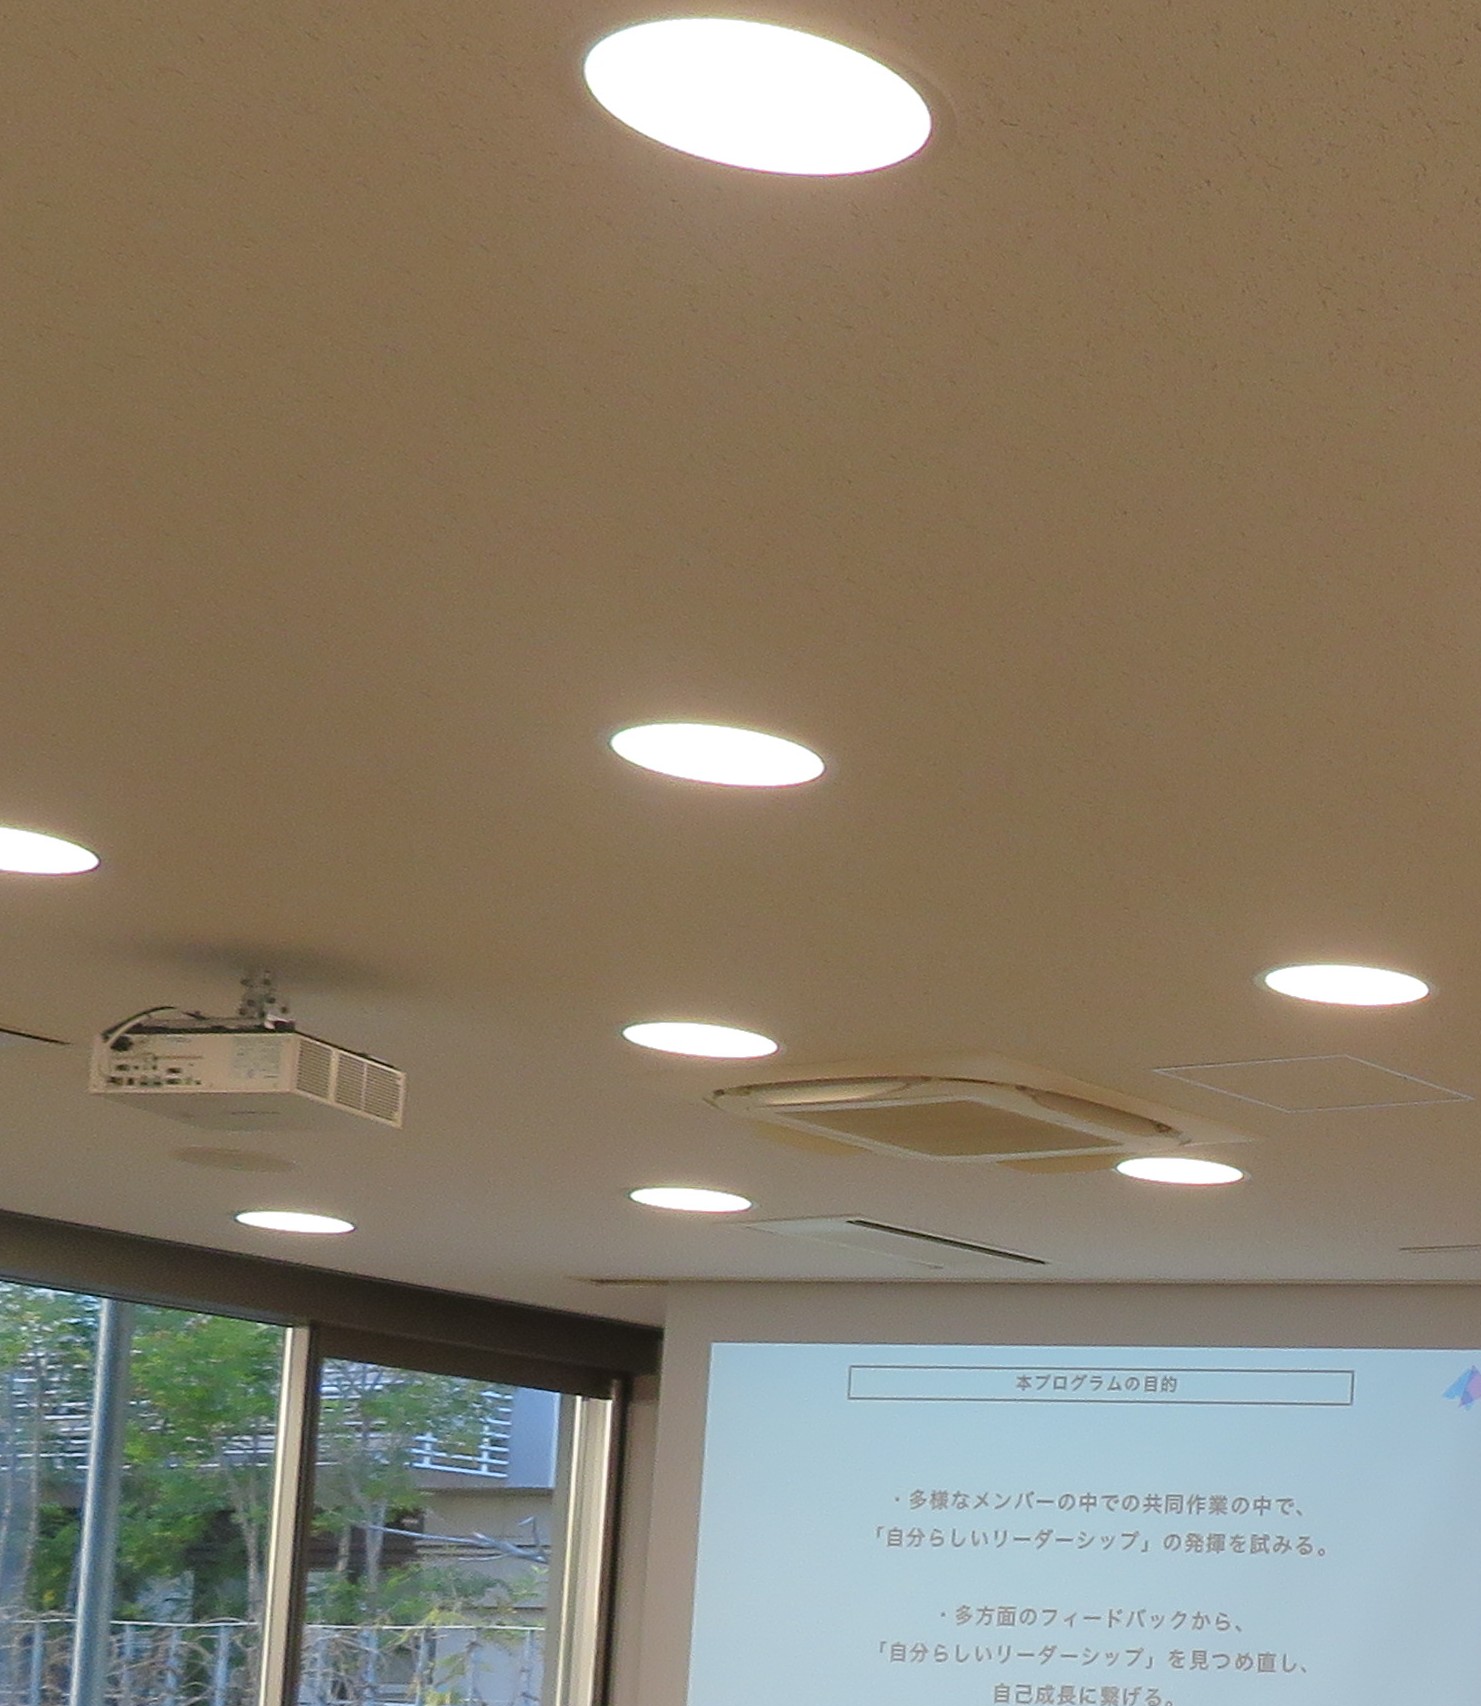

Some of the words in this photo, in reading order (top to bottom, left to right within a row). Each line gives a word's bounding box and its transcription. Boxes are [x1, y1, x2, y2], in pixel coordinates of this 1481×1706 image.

[1016, 1374, 1178, 1394] 本プログラムの目的
[873, 1526, 1329, 1558] 「自分らしいリーダーシップ」の発揮を試みる。
[877, 1641, 1308, 1675] 「自分らしいリーダーシップ」を見つめ直し、
